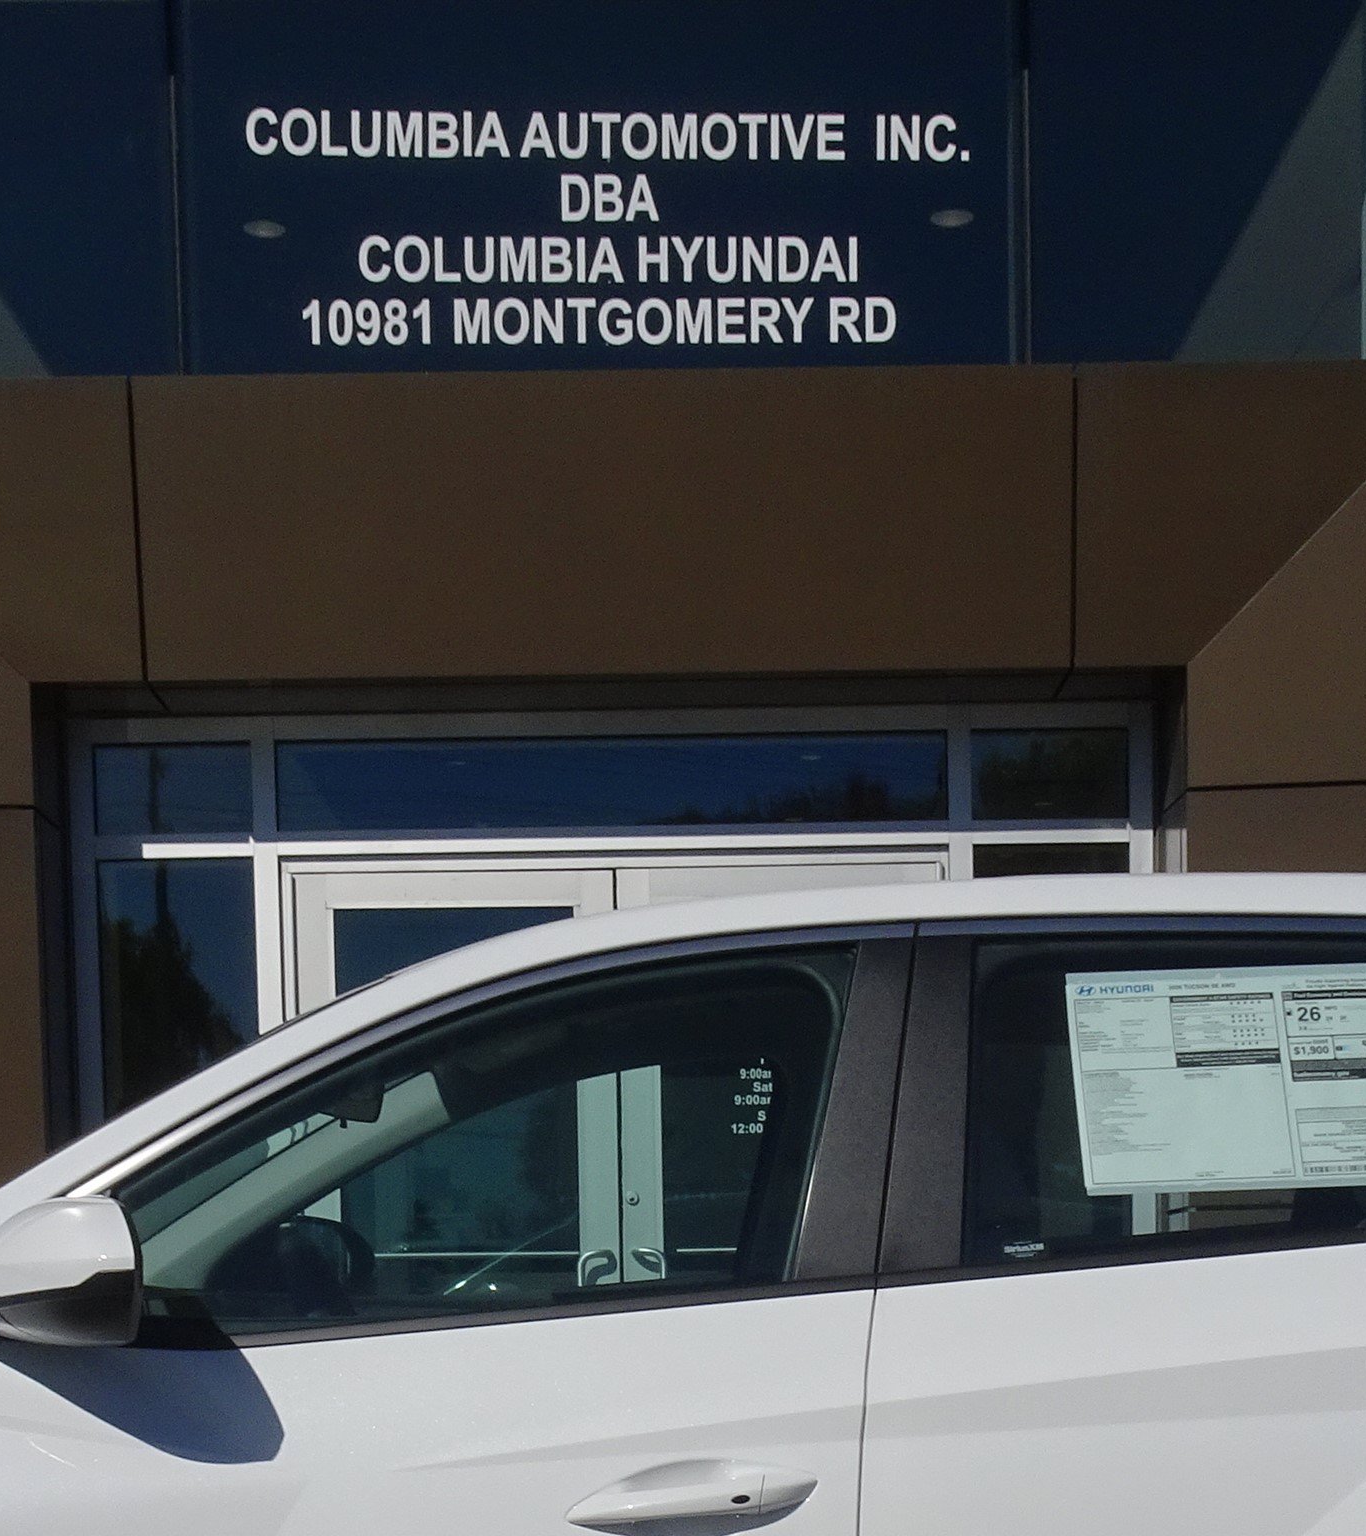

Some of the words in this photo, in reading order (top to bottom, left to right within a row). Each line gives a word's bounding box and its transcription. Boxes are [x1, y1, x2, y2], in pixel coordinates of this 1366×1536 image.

[245, 107, 511, 159] COLUMBIA
[520, 111, 846, 161] AUTOMOTIVE
[875, 114, 971, 162] INC.
[560, 173, 660, 222] DBA
[358, 235, 625, 284] COLUMBIA
[638, 235, 859, 283] HYUNDAI
[301, 299, 432, 346] 10981
[452, 297, 815, 346] MONTGOMERY
[829, 296, 898, 343] RD
[1099, 984, 1154, 994] HYUNDAI
[1297, 1006, 1322, 1021] 26
[753, 1081, 773, 1093] Sat
[731, 1123, 764, 1134] 12:00
